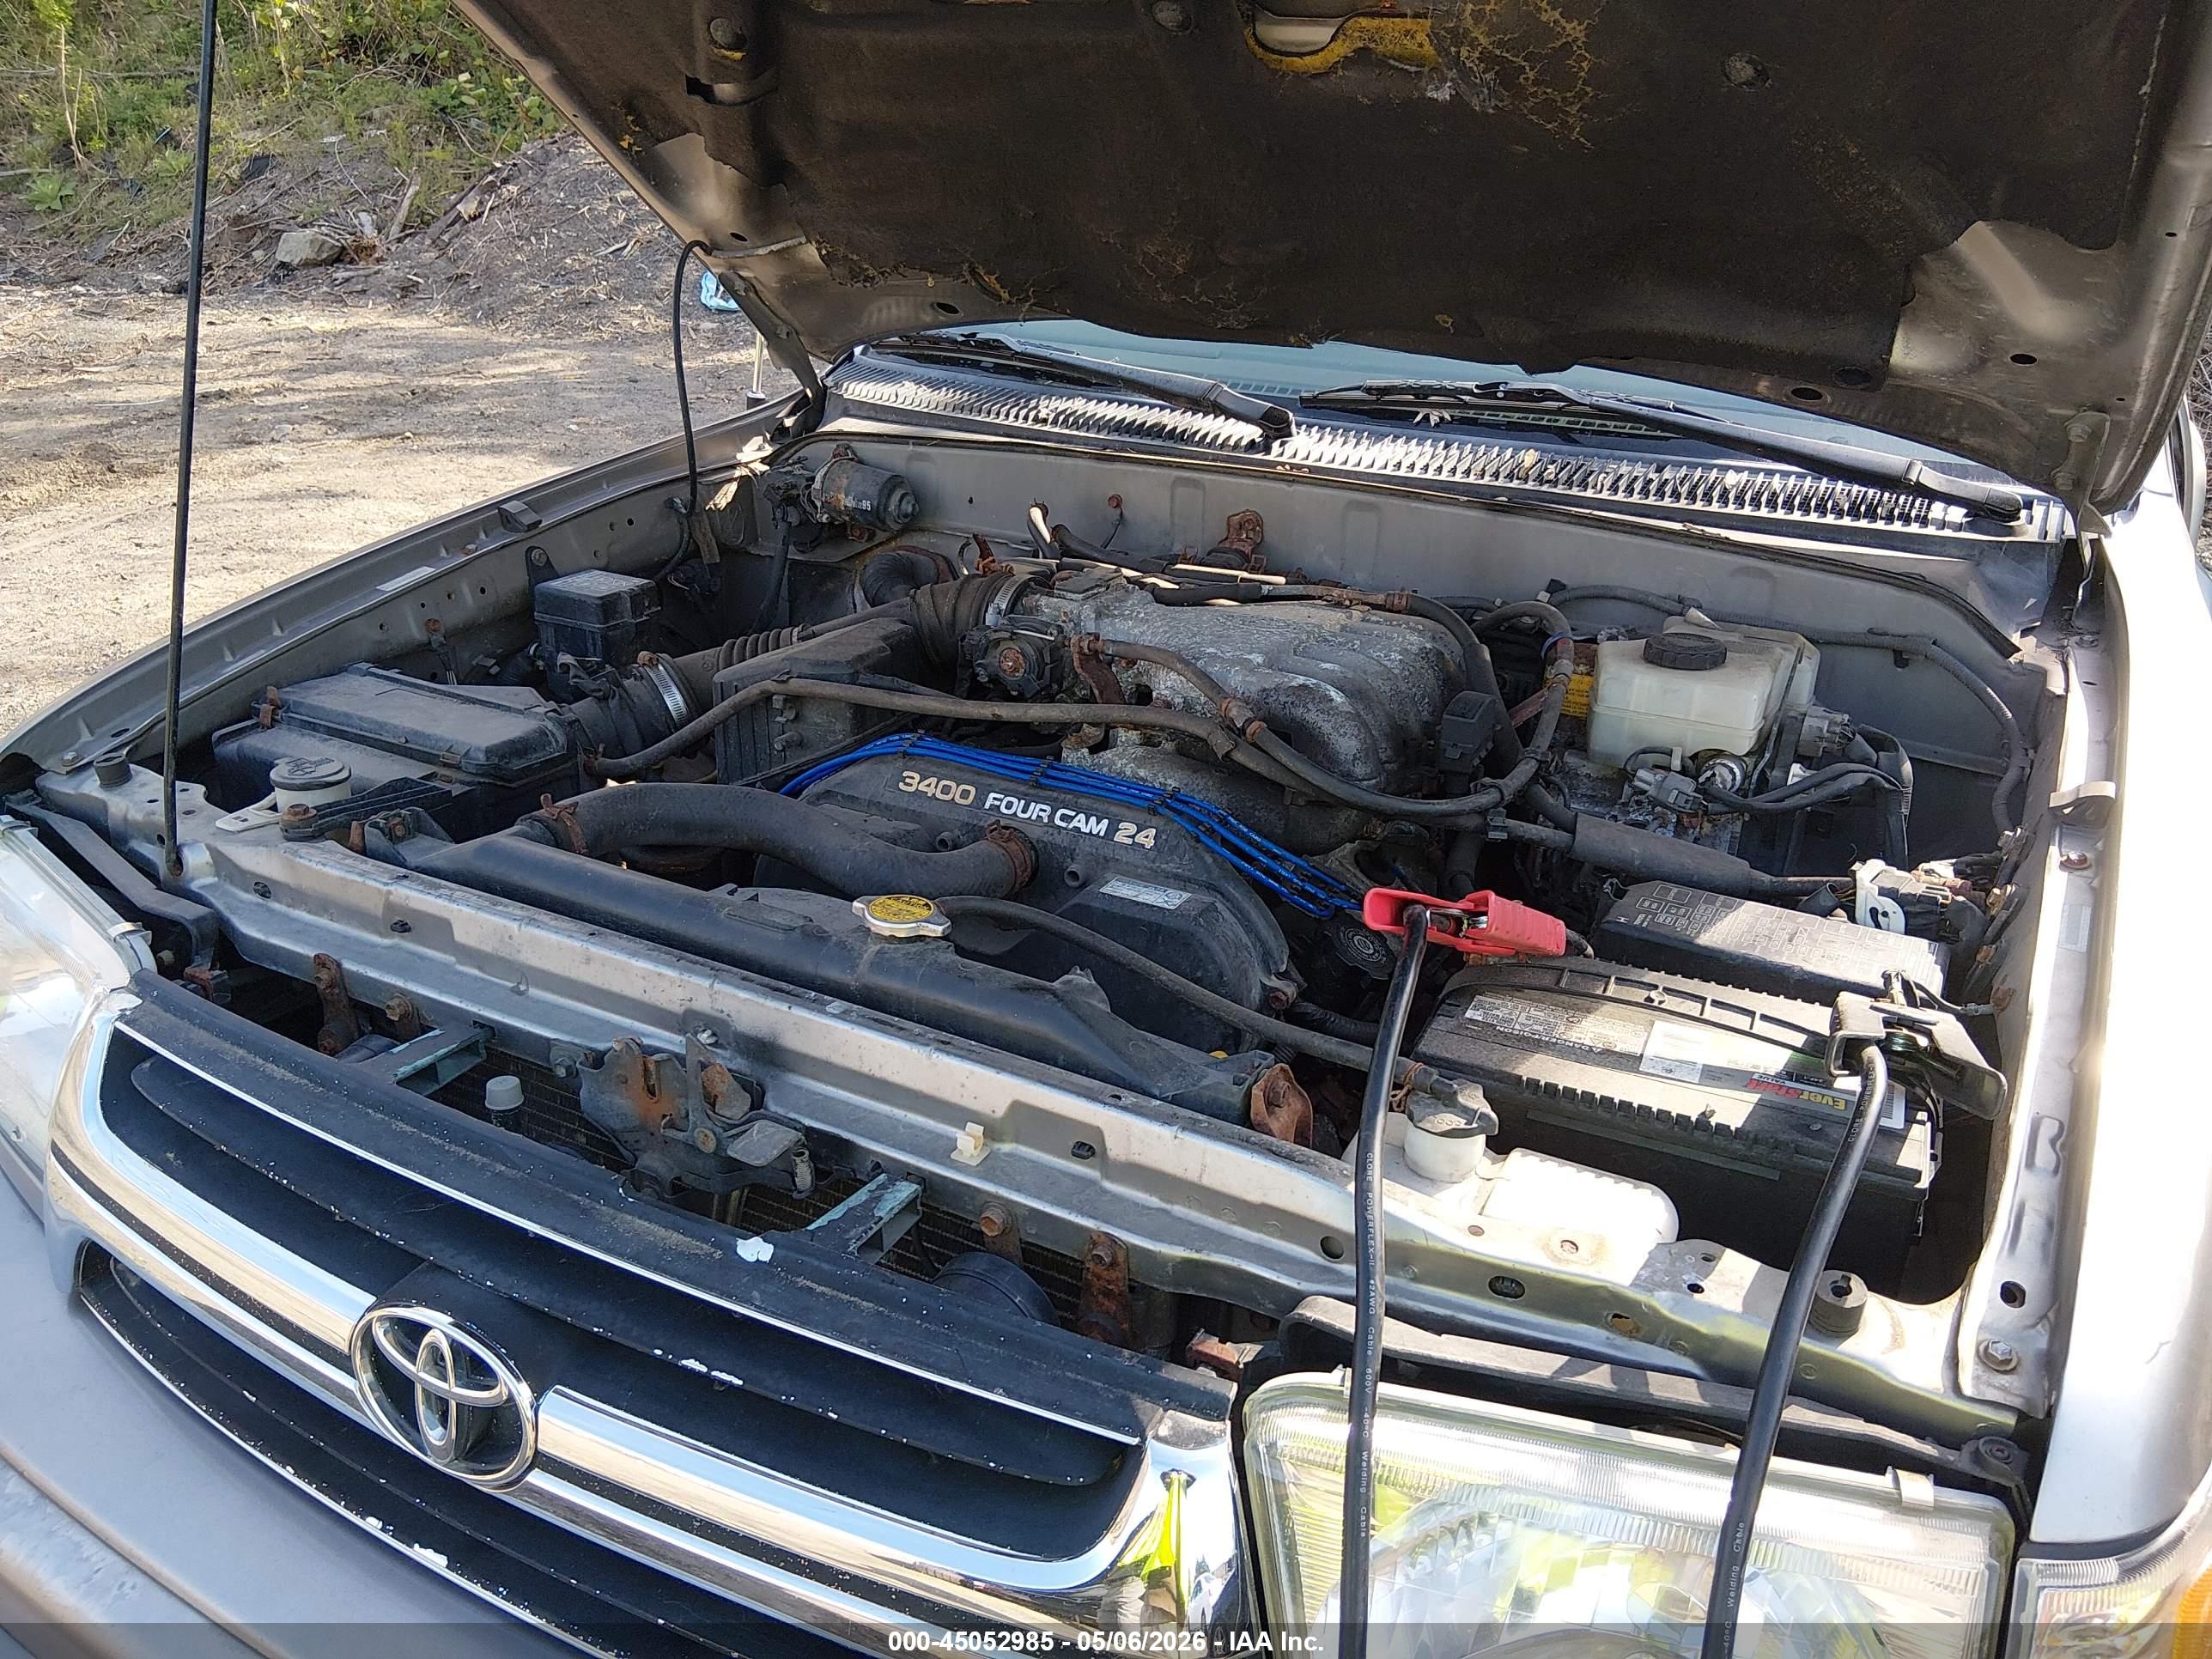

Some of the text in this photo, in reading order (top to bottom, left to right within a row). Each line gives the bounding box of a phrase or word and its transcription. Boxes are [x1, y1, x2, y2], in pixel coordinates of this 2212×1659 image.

[898, 770, 1157, 849] 3400 FOUR CAM 24
[1495, 1025, 1590, 1051] DANGER/POISON
[1756, 1074, 1786, 1085] VALUE
[1848, 1118, 1864, 1142] CLORE
[1366, 1327, 1375, 1356] Cable
[1359, 1451, 1369, 1493] Welding
[1732, 1522, 1746, 1552] Cable
[1726, 1565, 1739, 1607] Welding
